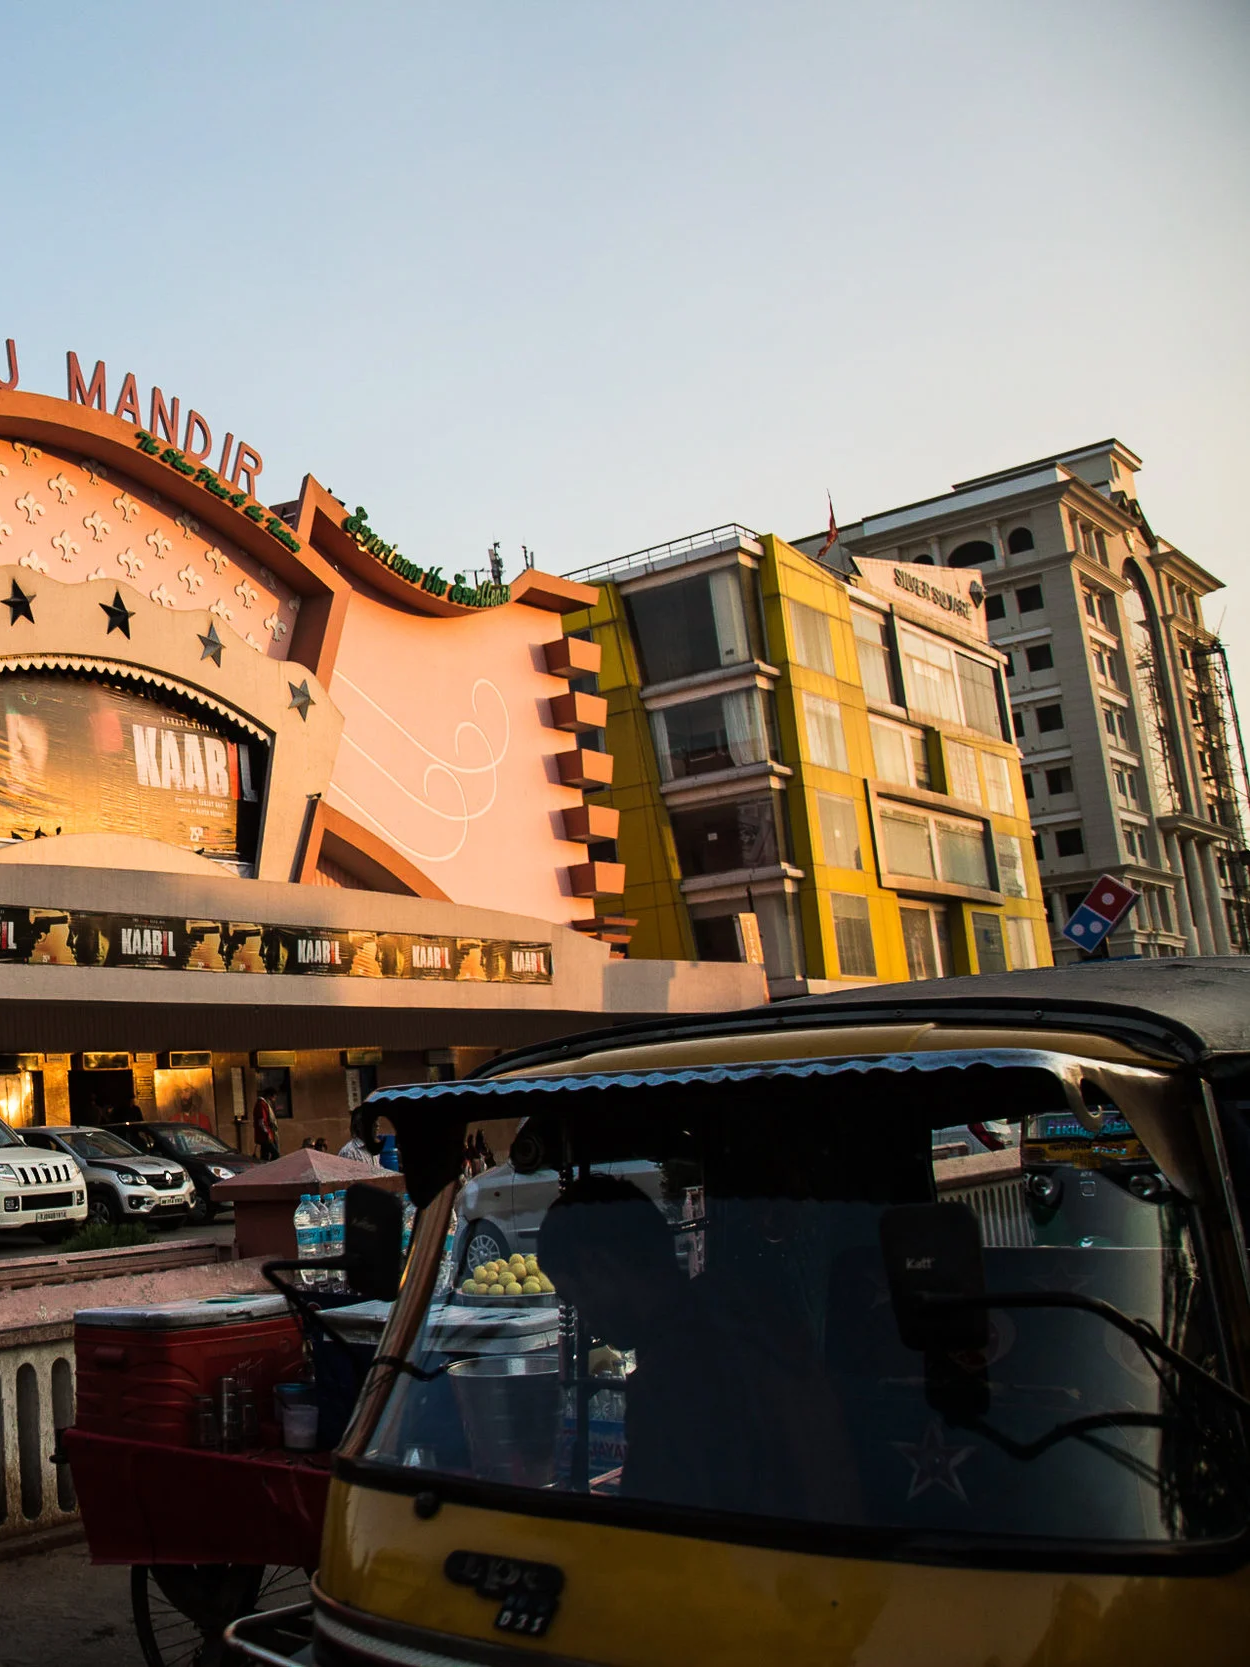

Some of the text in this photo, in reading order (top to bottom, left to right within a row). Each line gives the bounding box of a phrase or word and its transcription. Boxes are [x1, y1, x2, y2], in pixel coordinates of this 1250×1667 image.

[67, 351, 263, 500] MANDIR
[894, 568, 931, 601] SILVER
[133, 724, 259, 802] KAABIL
[121, 928, 176, 957] KAABIL
[297, 939, 342, 965] KAABIL
[412, 945, 451, 969] KAABIL
[512, 951, 548, 973] KAABIL
